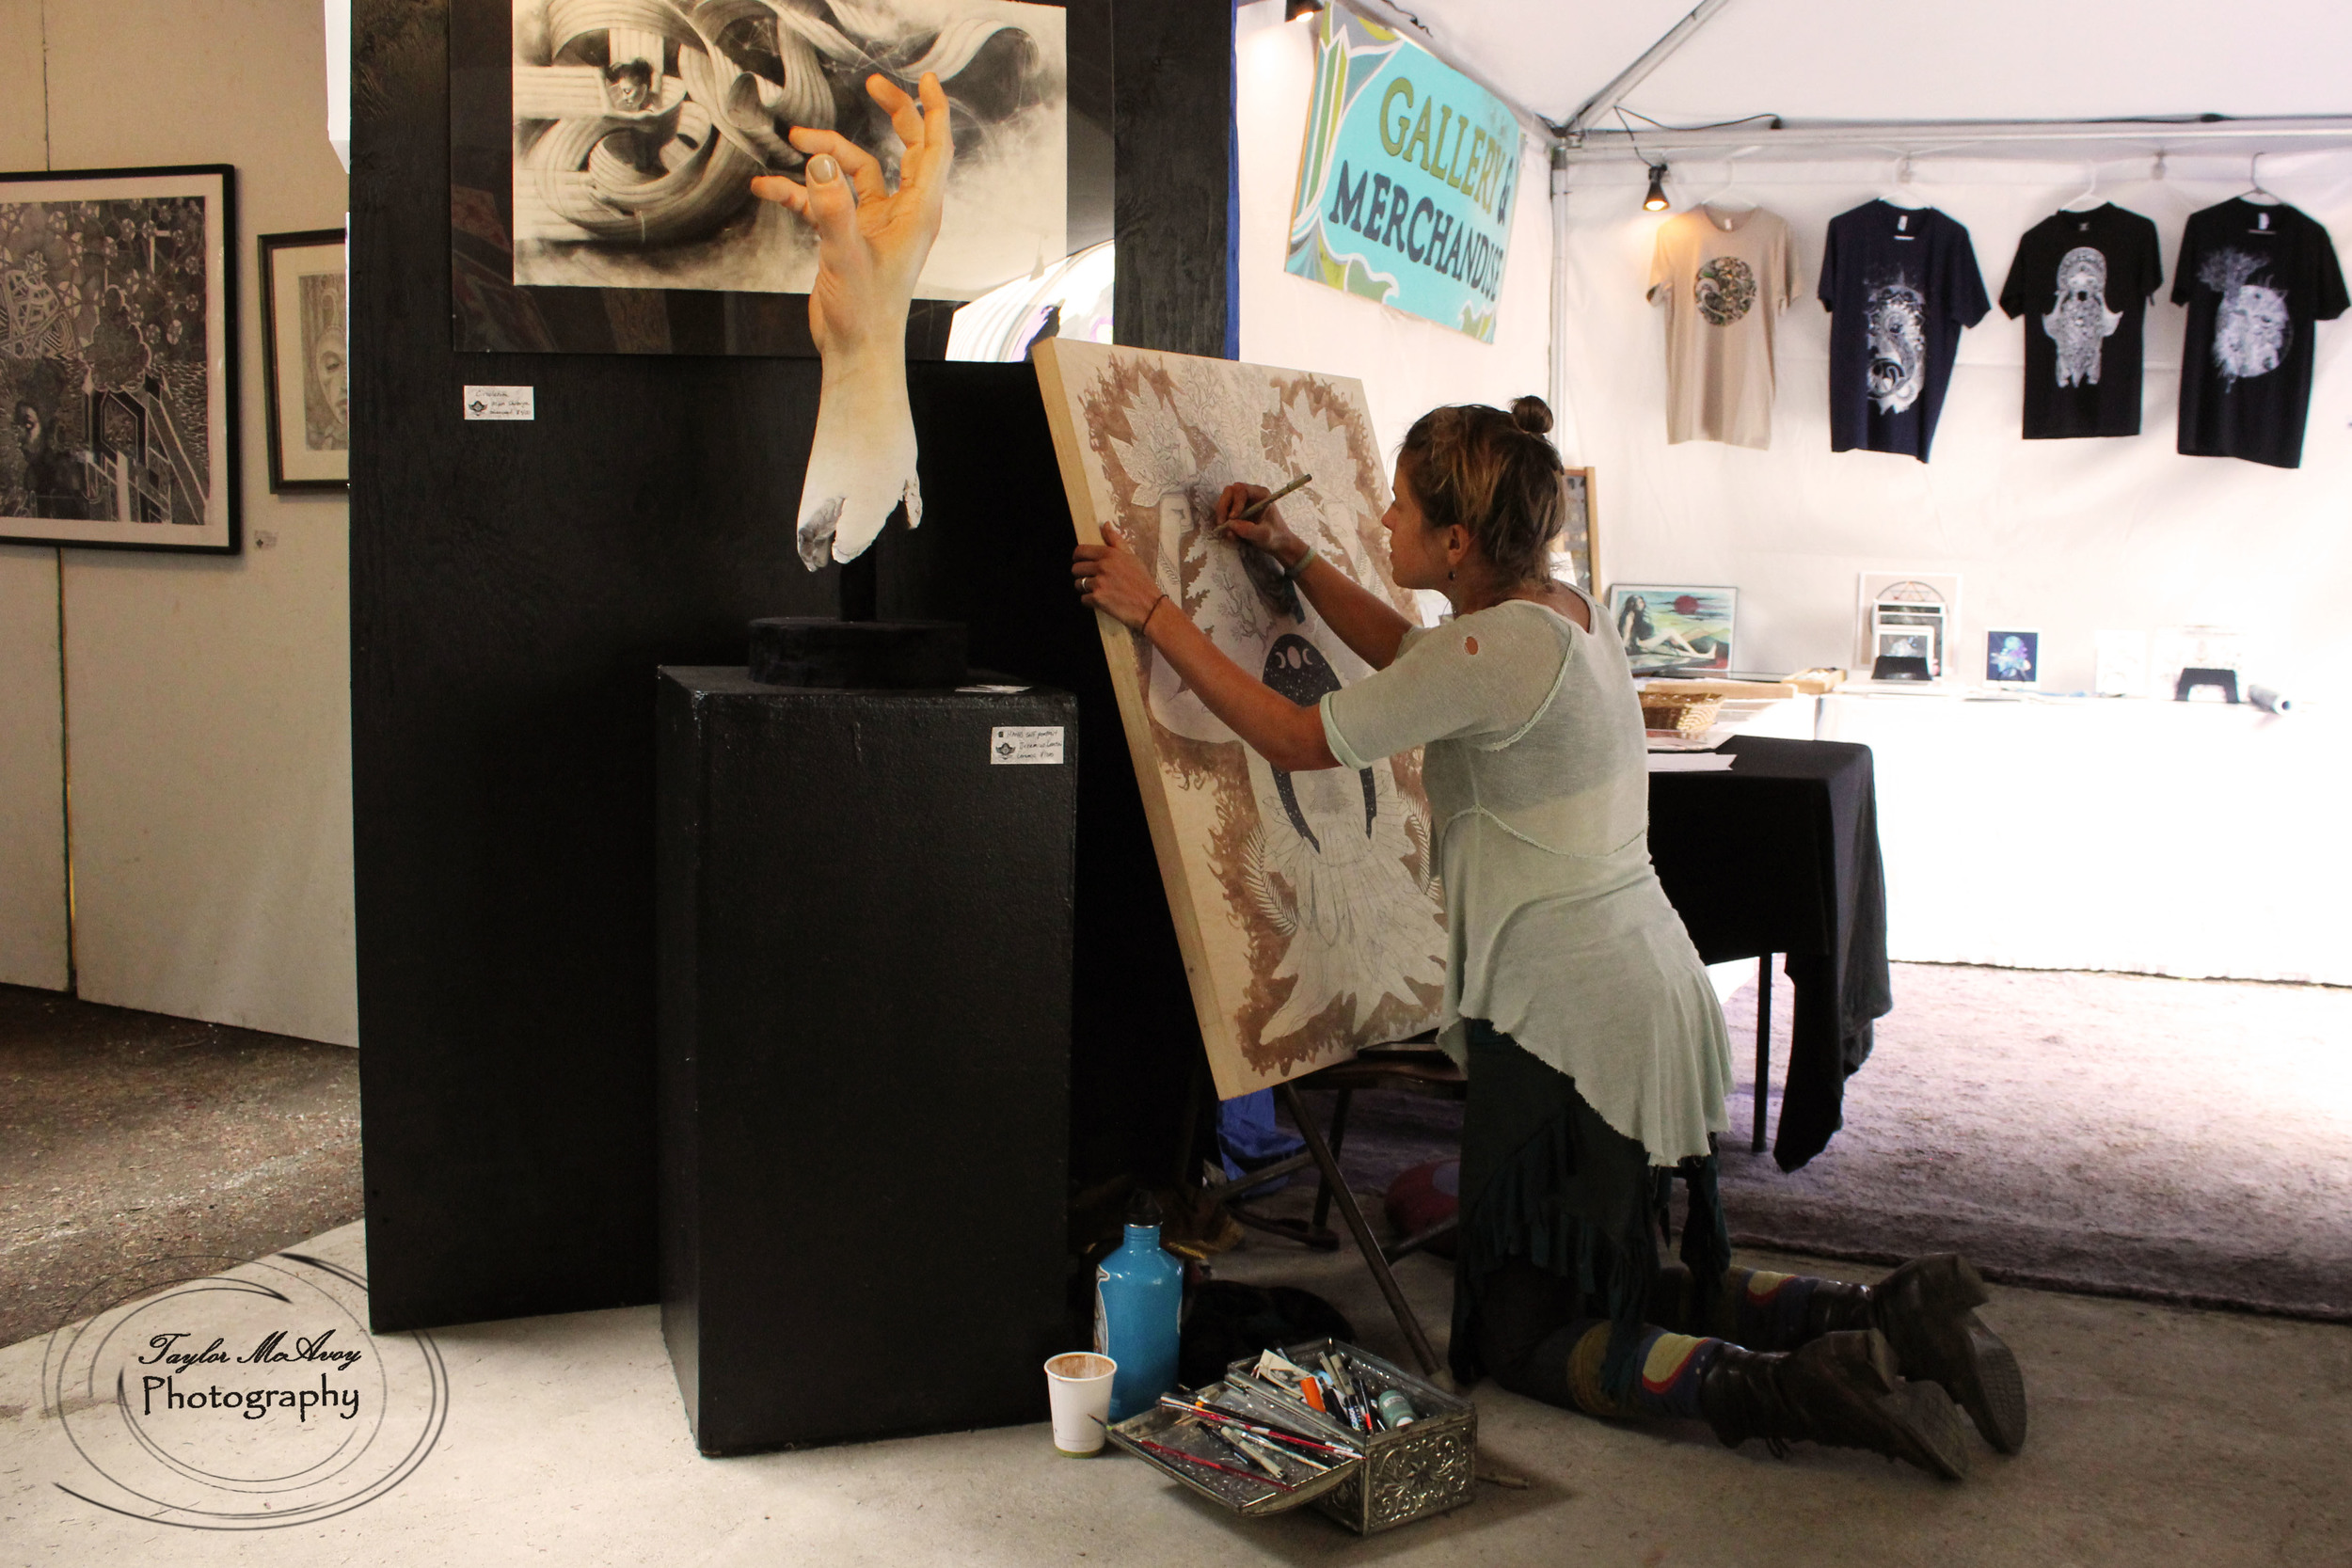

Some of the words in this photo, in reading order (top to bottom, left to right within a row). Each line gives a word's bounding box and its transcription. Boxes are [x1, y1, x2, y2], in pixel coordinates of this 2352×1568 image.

[1379, 77, 1505, 214] GALLERY
[1498, 156, 1514, 225] &
[1328, 160, 1503, 303] MERCHANDISE
